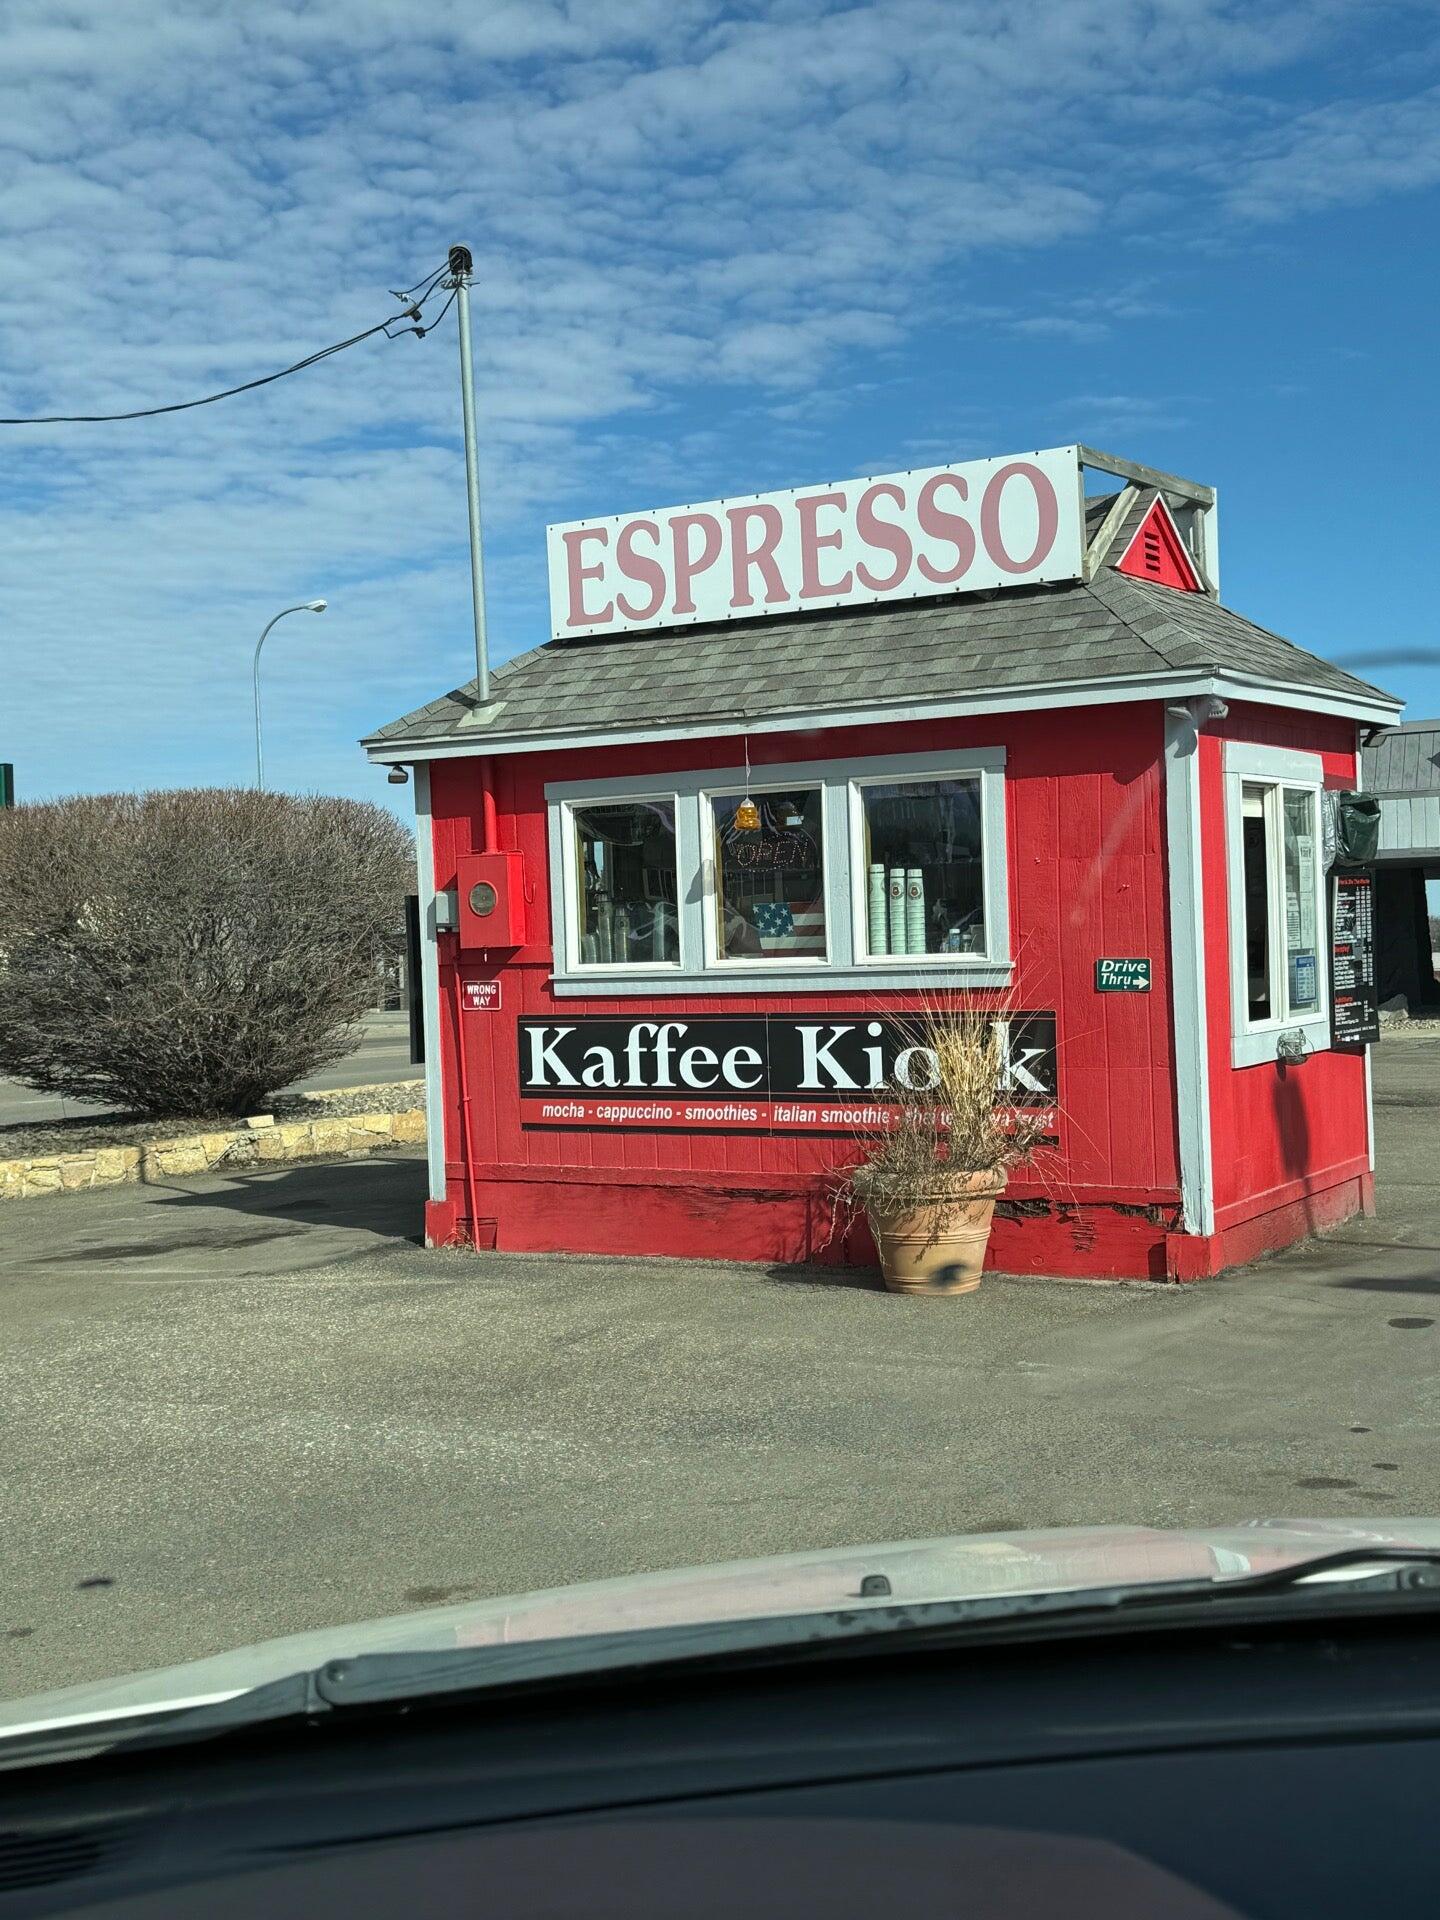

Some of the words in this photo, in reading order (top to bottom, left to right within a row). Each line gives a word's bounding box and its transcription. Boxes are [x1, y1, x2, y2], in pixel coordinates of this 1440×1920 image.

[562, 462, 1059, 627] ESPRESSO
[1101, 960, 1147, 972] Drive
[1101, 973, 1131, 985] Thru
[467, 985, 496, 995] WRONG
[473, 996, 490, 1006] WAY
[525, 1023, 763, 1089] Kaffee
[795, 1021, 1051, 1092] Kiok
[542, 1103, 585, 1118] mocha
[597, 1104, 673, 1122] cappuccino
[685, 1105, 757, 1122] smoothies
[773, 1105, 817, 1123] italian
[821, 1106, 890, 1124] smoothie
